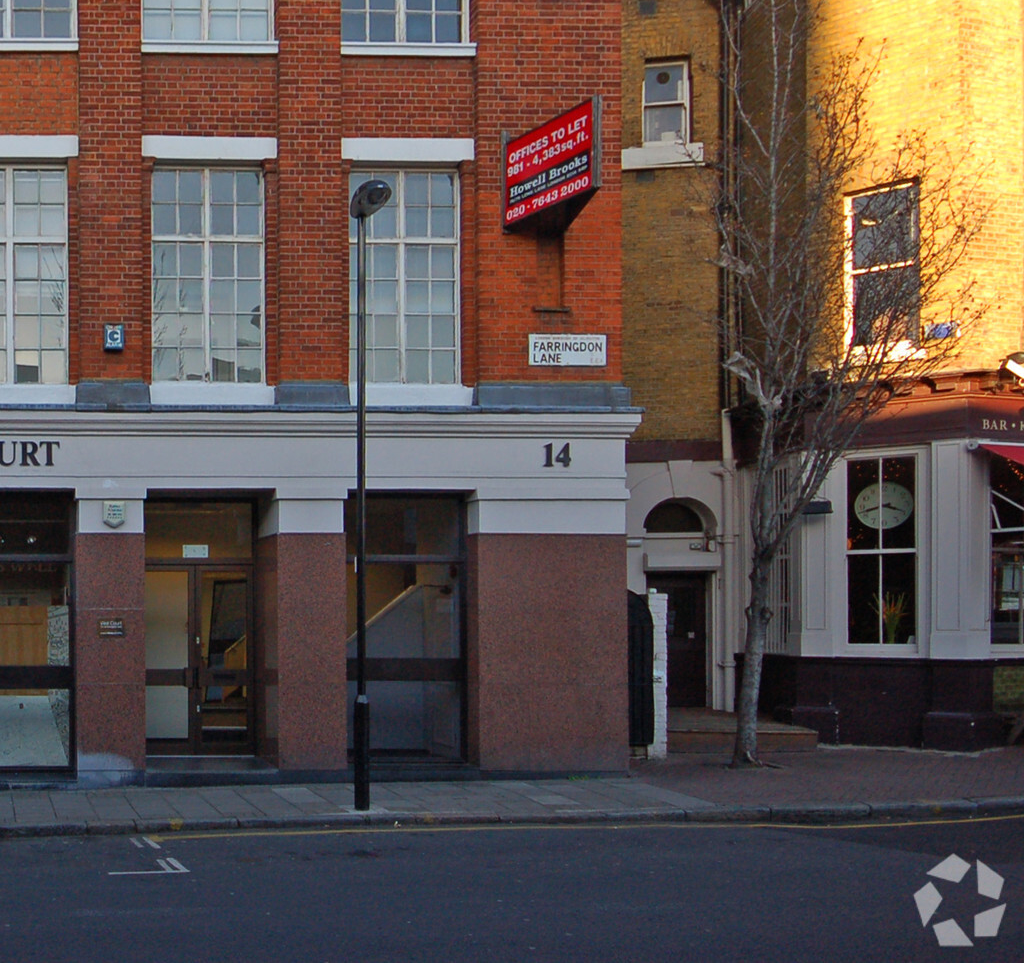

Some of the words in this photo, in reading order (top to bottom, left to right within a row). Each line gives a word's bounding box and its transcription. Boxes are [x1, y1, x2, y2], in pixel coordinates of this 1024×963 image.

[508, 136, 549, 164] OFFICES
[551, 128, 565, 143] TO
[568, 115, 588, 135] LET
[507, 163, 524, 177] 981
[509, 172, 546, 198] Howell
[548, 155, 588, 180] Brooks
[506, 204, 525, 221] 020
[532, 190, 559, 209] 7643
[560, 176, 589, 197] 2000
[533, 341, 603, 352] FARRINGDON
[533, 353, 562, 363] LANE
[982, 418, 1008, 431] BAR
[542, 442, 572, 468] 14
